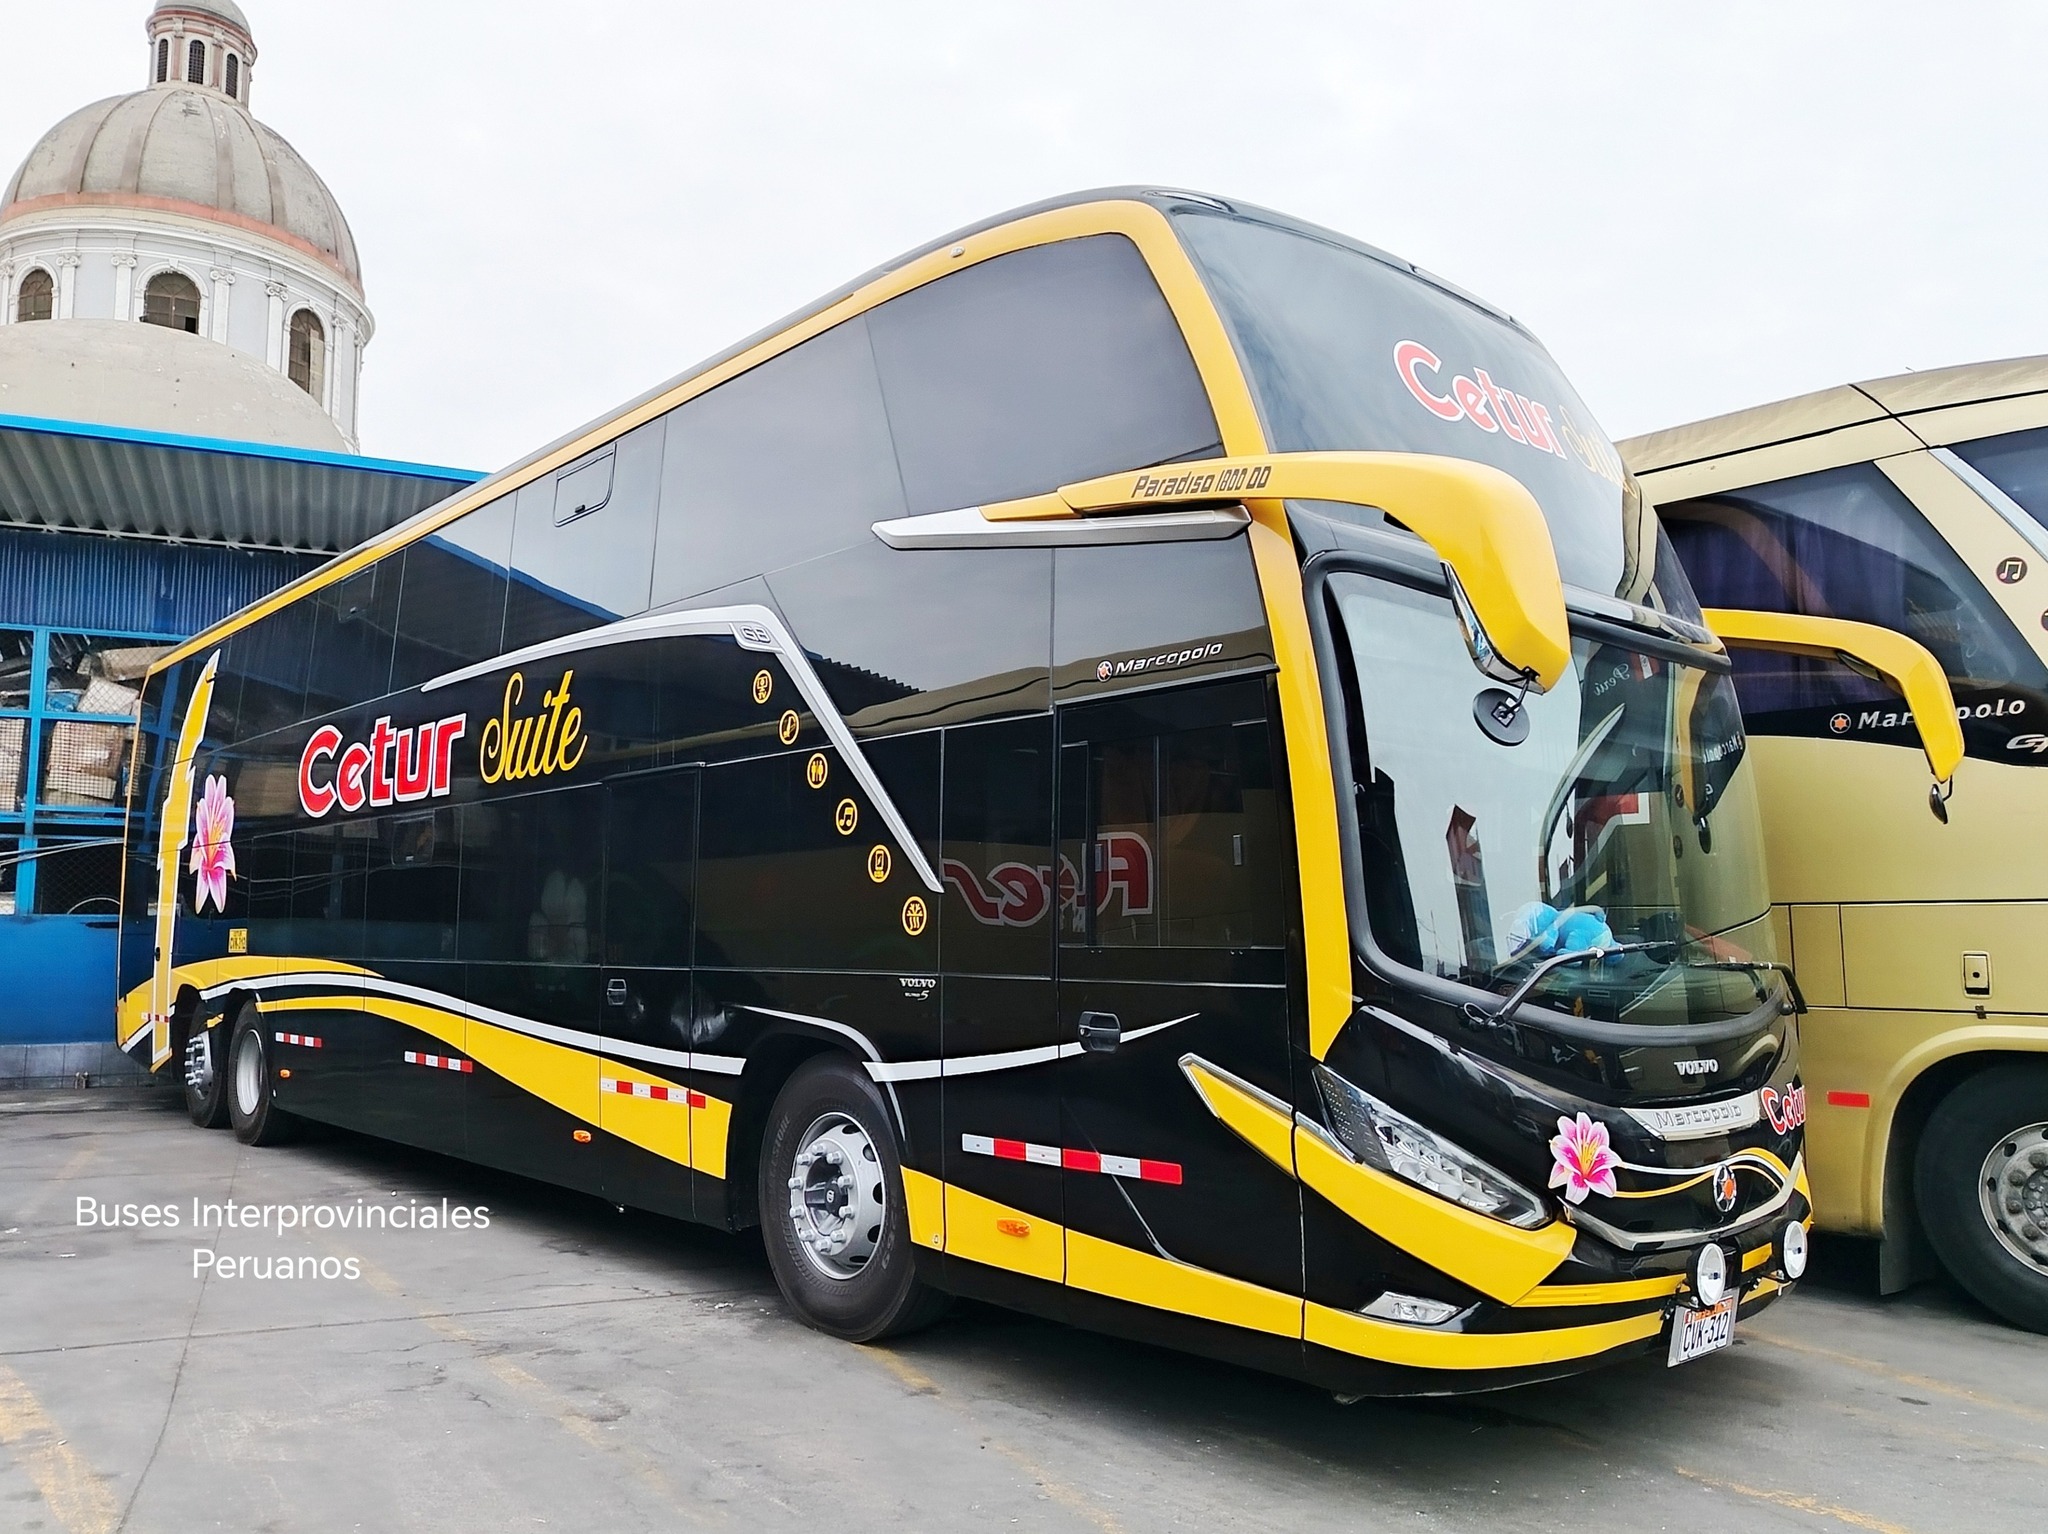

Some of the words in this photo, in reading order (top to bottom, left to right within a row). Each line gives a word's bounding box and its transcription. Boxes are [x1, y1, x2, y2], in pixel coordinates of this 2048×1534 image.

[1393, 340, 1568, 460] Cetur
[1131, 471, 1216, 498] Paradiso
[1215, 467, 1249, 492] 1800
[1115, 642, 1224, 676] Marcopolo
[1857, 698, 2026, 730] Marpolo
[298, 713, 467, 819] Cetur
[480, 669, 588, 784] Suite
[899, 977, 937, 989] VOLVO
[1673, 1058, 1719, 1076] VOLVO
[1654, 1101, 1743, 1130] Marcopolo
[1683, 1311, 1729, 1353] CVK-312
